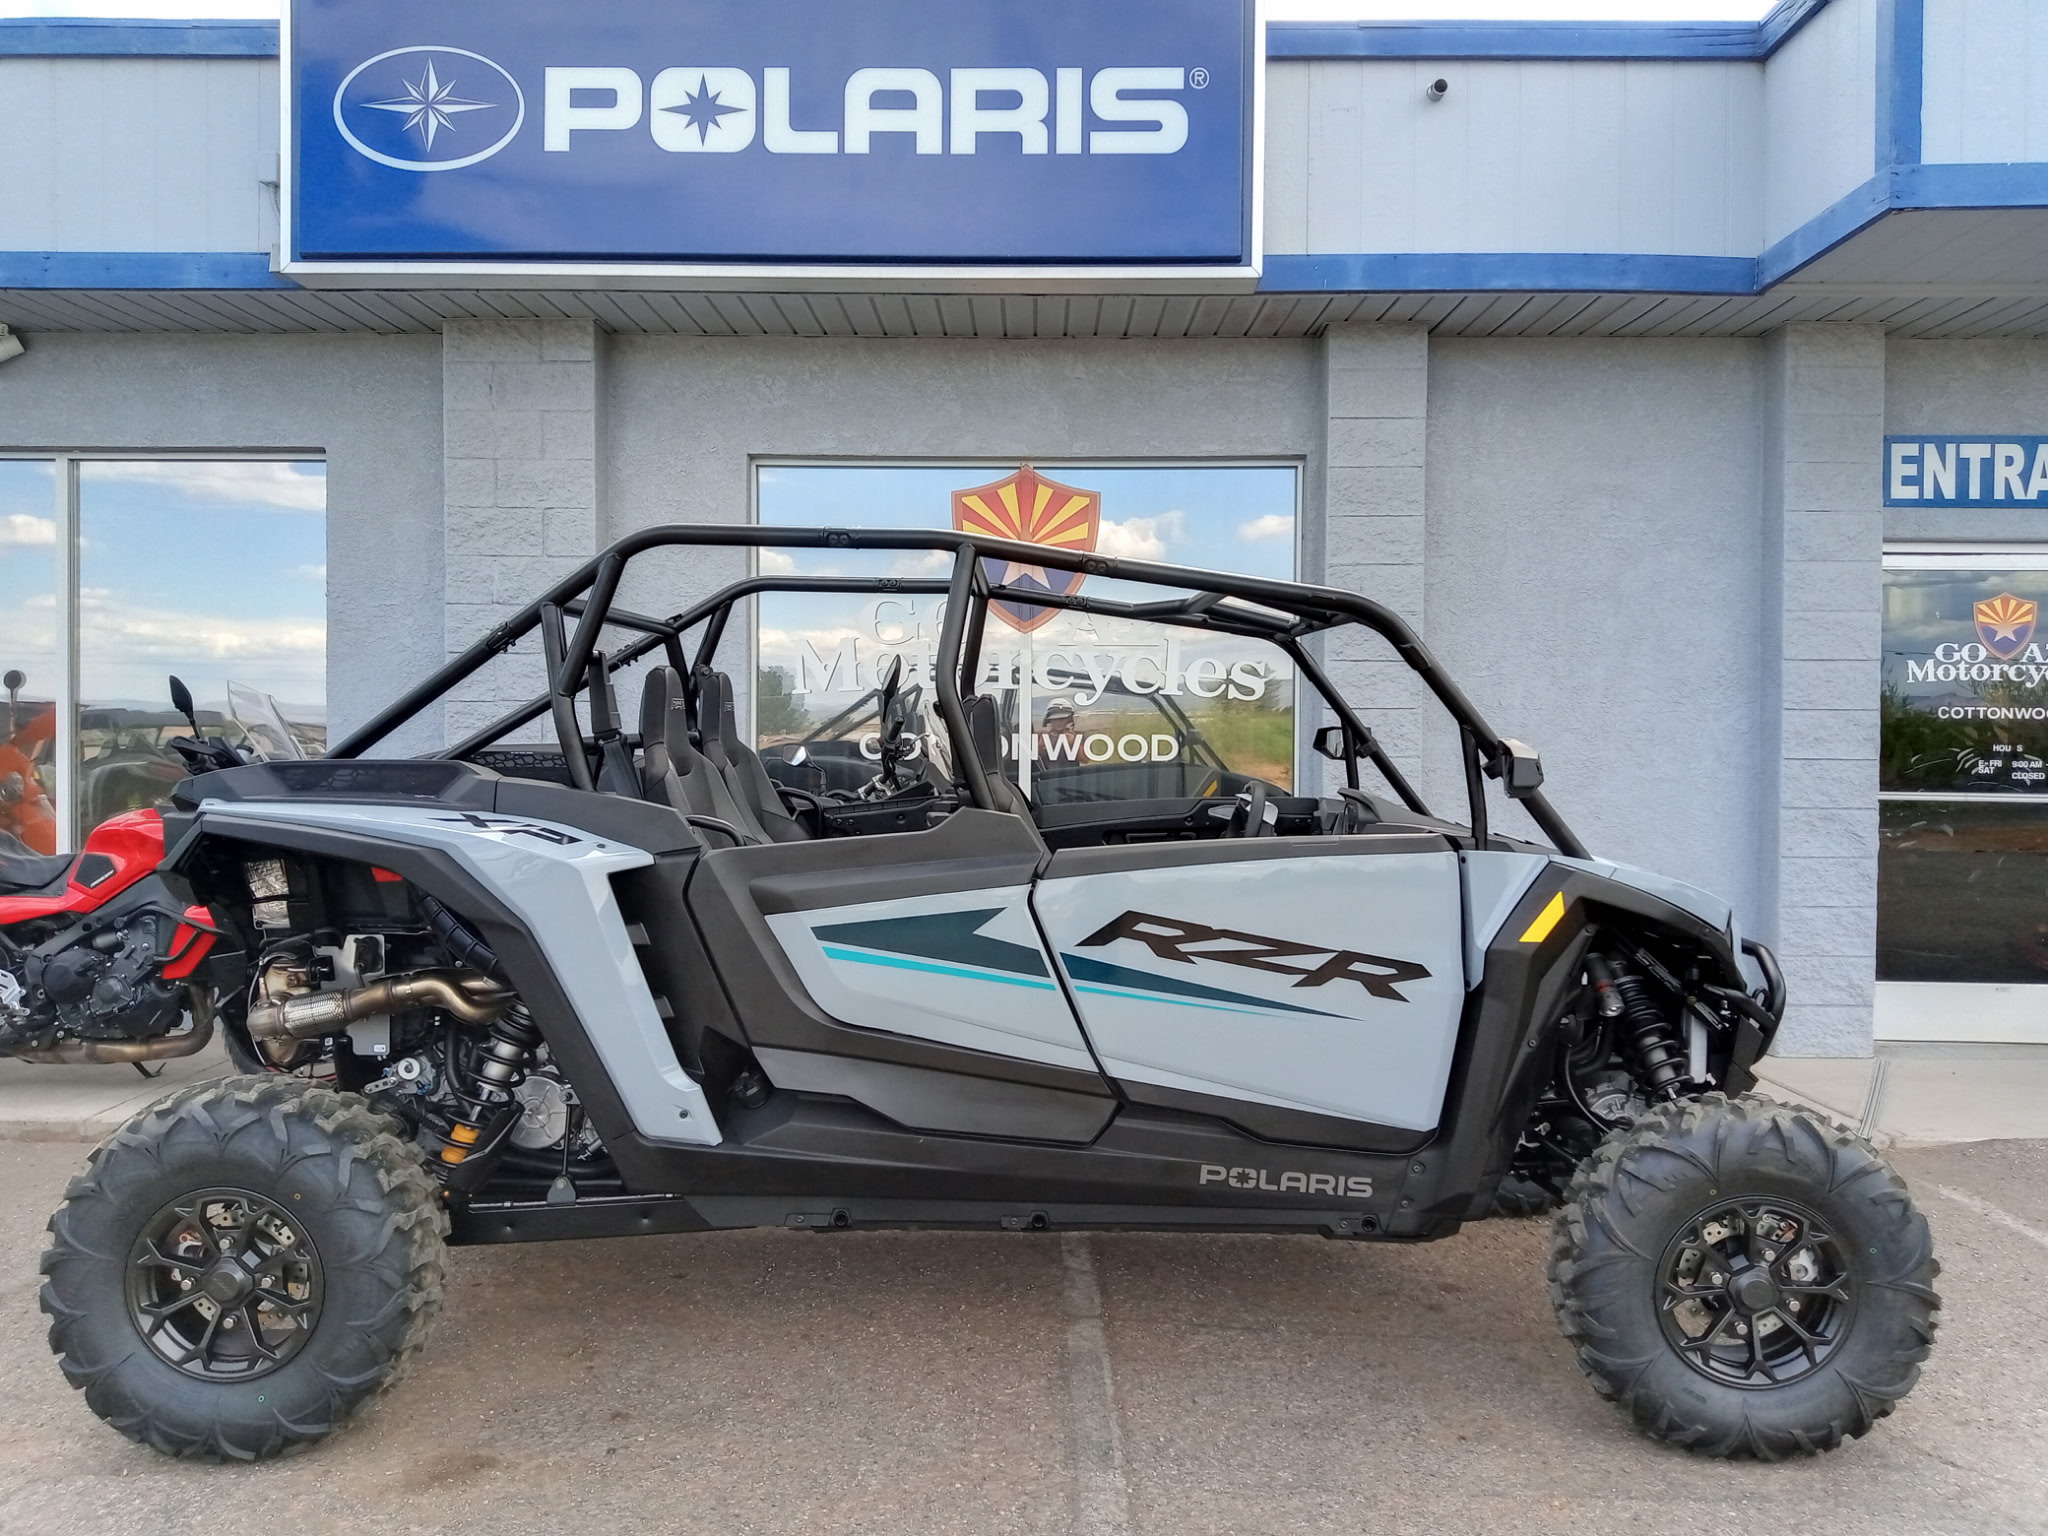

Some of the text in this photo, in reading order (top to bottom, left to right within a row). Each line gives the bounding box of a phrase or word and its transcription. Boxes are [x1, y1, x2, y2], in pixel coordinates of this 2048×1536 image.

[1934, 642, 2048, 664] GO A
[1906, 658, 2048, 688] Motorcy
[1937, 706, 2048, 720] COTTONWO
[859, 732, 1180, 762] CONWOOD
[1977, 766, 2046, 780] SAT CLOSED
[1073, 909, 1434, 1004] RZR
[1199, 1164, 1374, 1198] POLARIS
